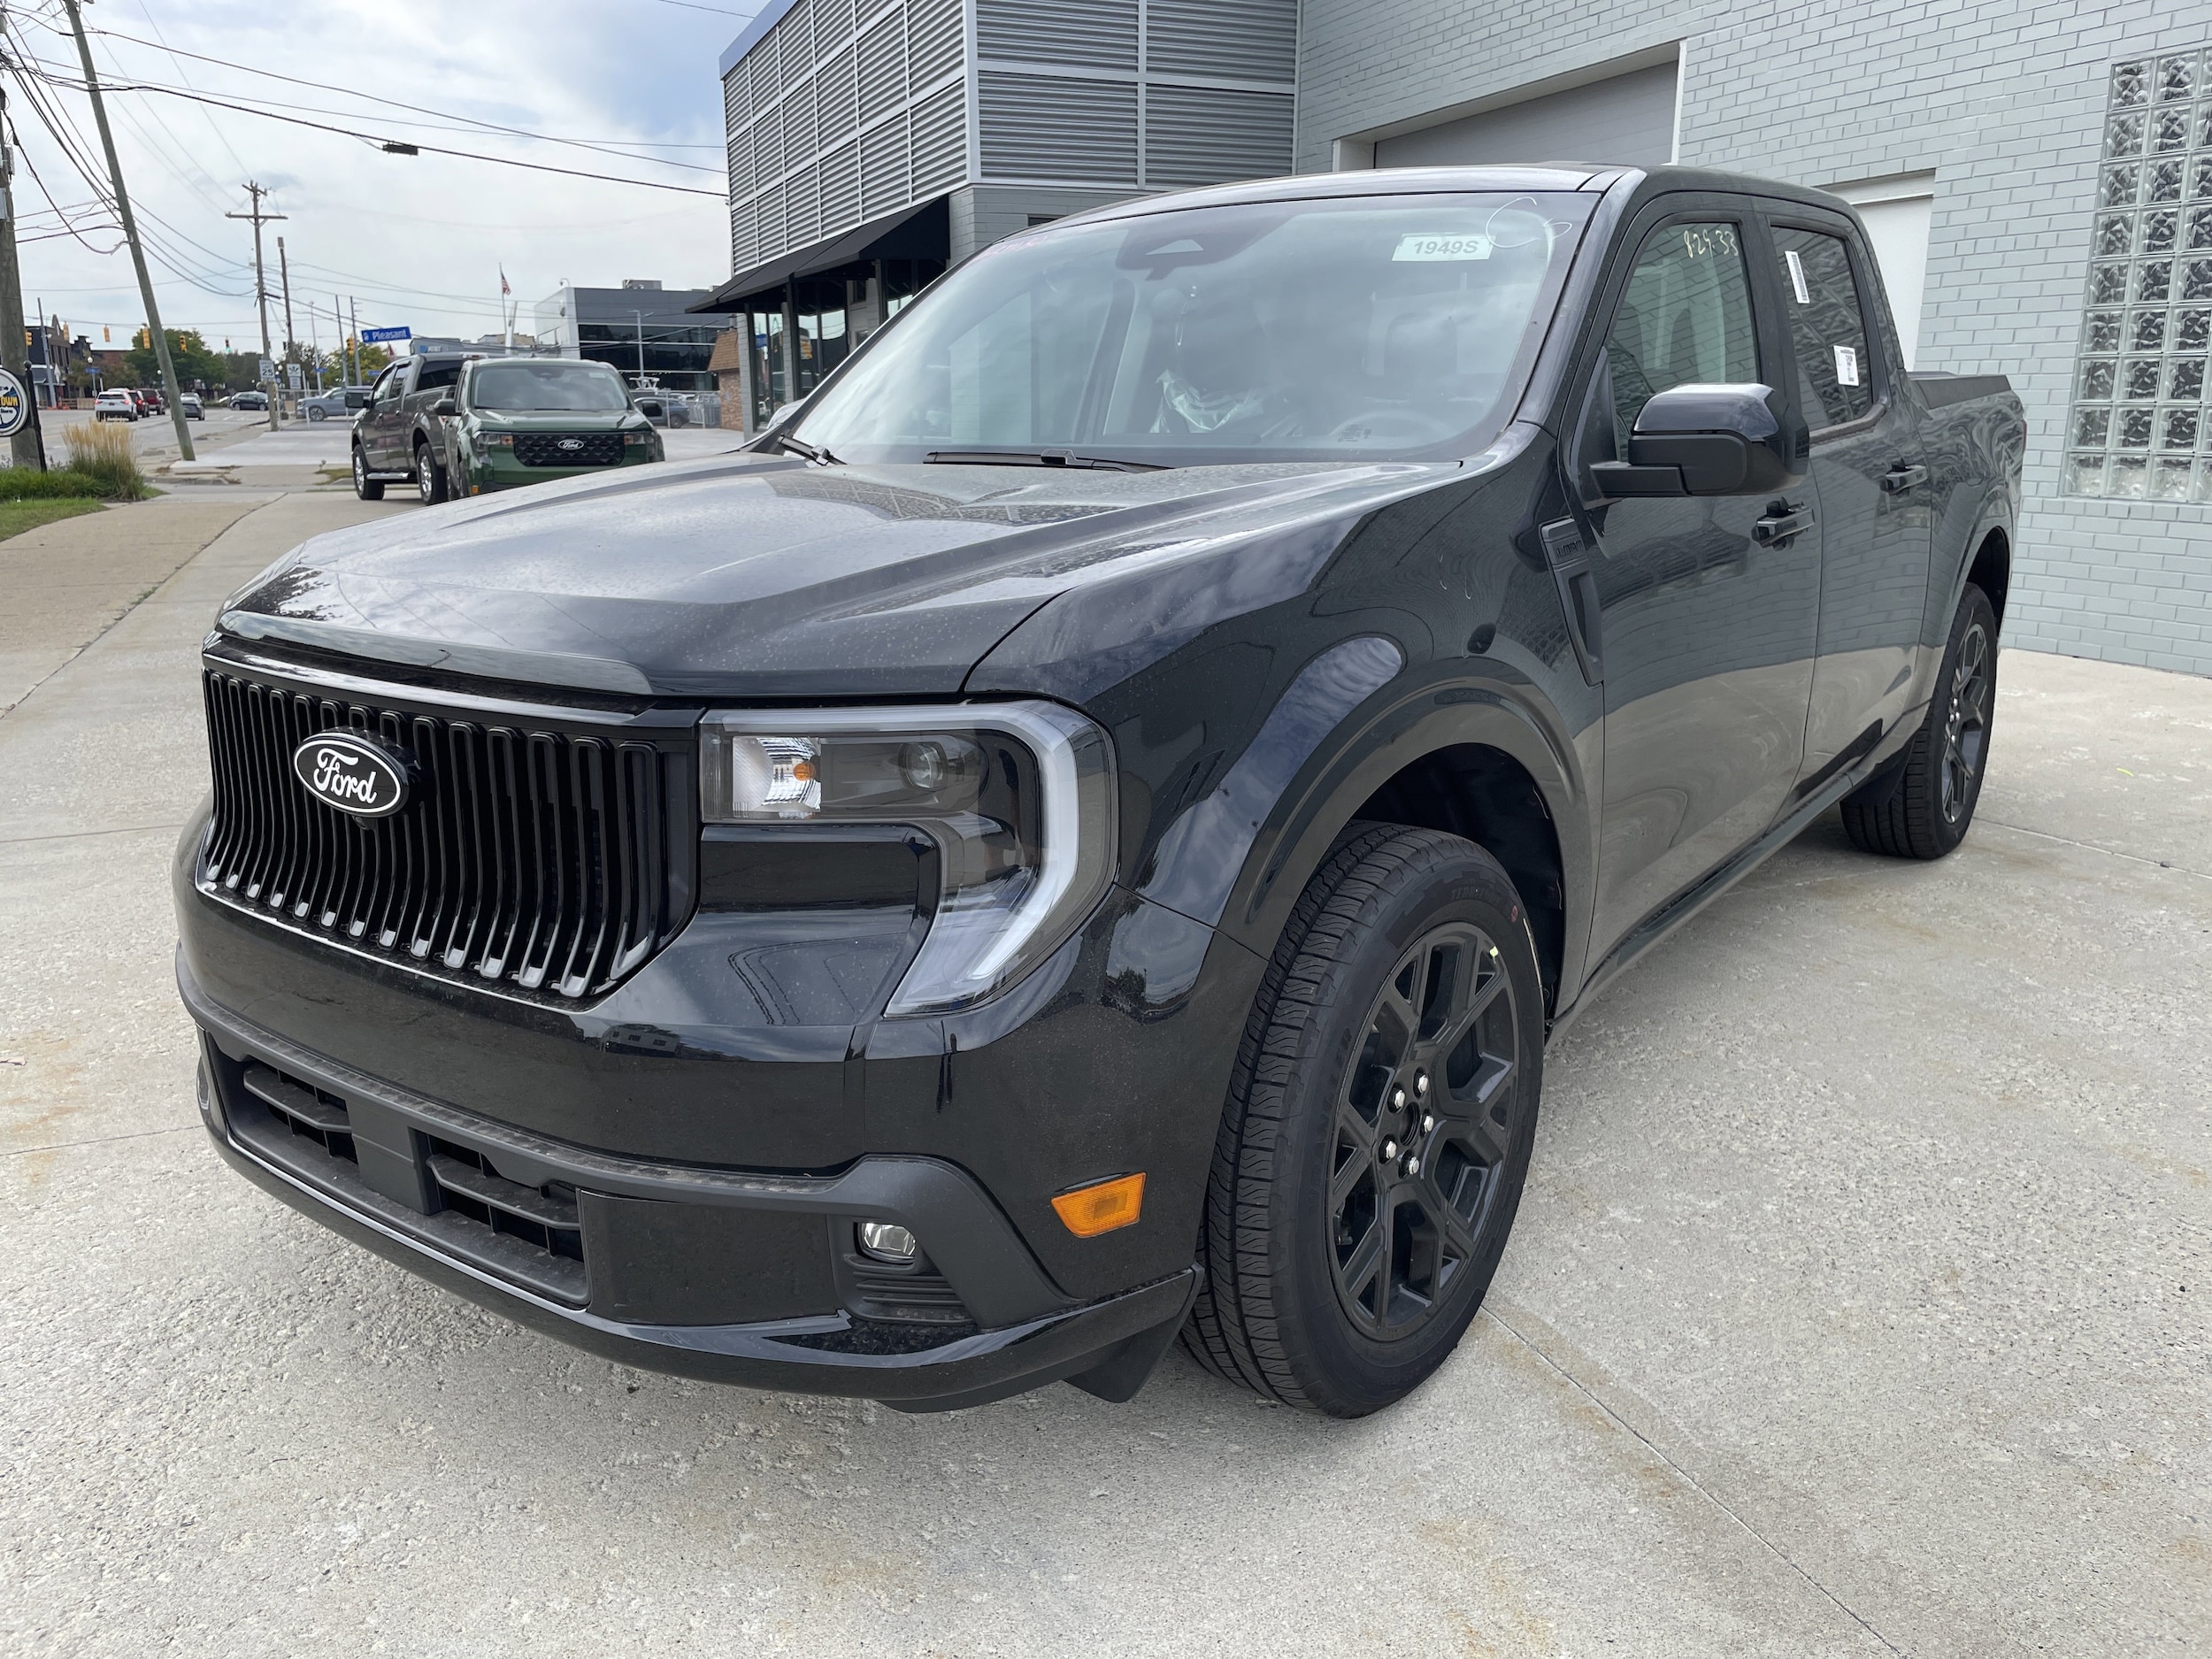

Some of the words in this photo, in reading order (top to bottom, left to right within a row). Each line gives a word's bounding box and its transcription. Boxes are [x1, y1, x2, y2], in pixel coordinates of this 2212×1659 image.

[1413, 240, 1479, 255] 1949S
[372, 329, 408, 341] Pleasant
[313, 748, 378, 804] Ford
